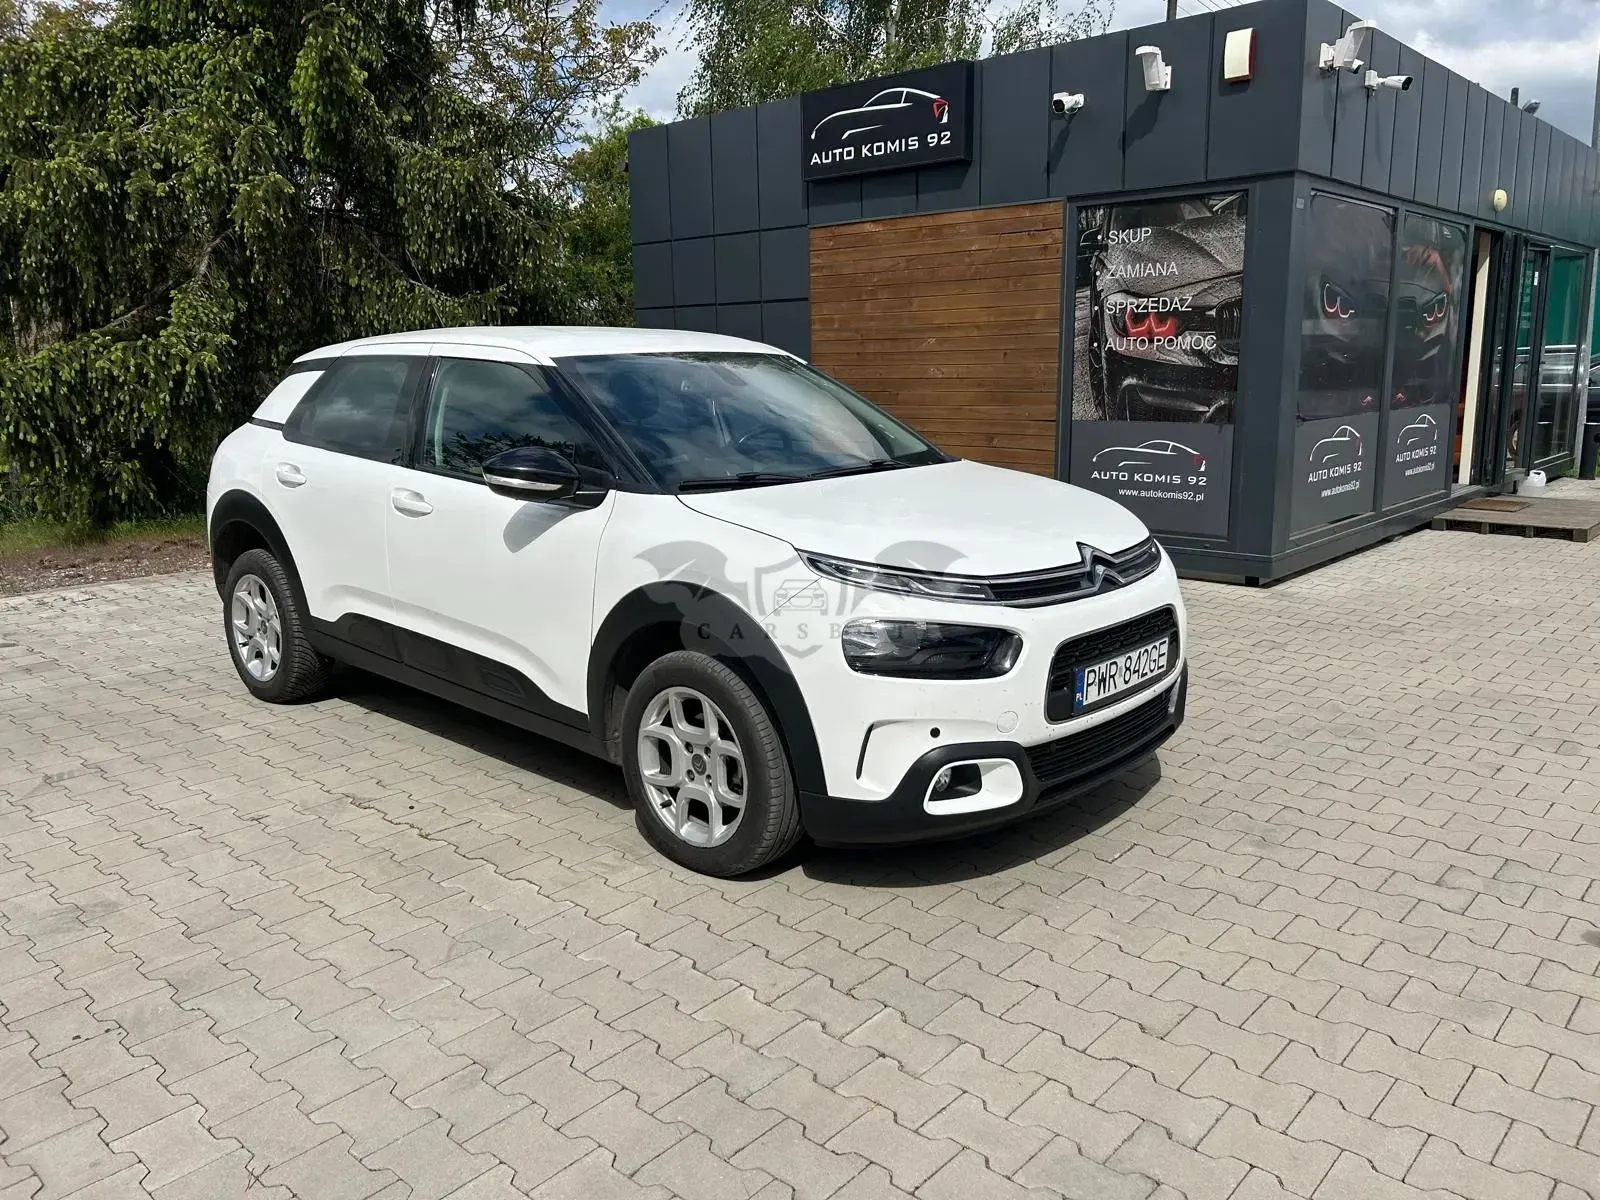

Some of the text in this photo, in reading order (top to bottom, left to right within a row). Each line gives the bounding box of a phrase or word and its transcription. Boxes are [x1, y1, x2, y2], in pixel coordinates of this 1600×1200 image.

[810, 131, 951, 165] AUTO KOMIS 92
[1108, 227, 1152, 245] SKUP
[1106, 262, 1178, 278] ZAMIANA
[1104, 335, 1217, 351] AUTO POMOC
[1396, 445, 1437, 462] AUTO KOMIS 92
[1091, 470, 1207, 486] AUTO KOMIS 92
[1308, 461, 1362, 483] AUTO KOMIS 92
[1118, 488, 1204, 502] www.autokomis92.pl
[1085, 640, 1167, 701] PWR 842GE
[1076, 693, 1083, 701] PL
